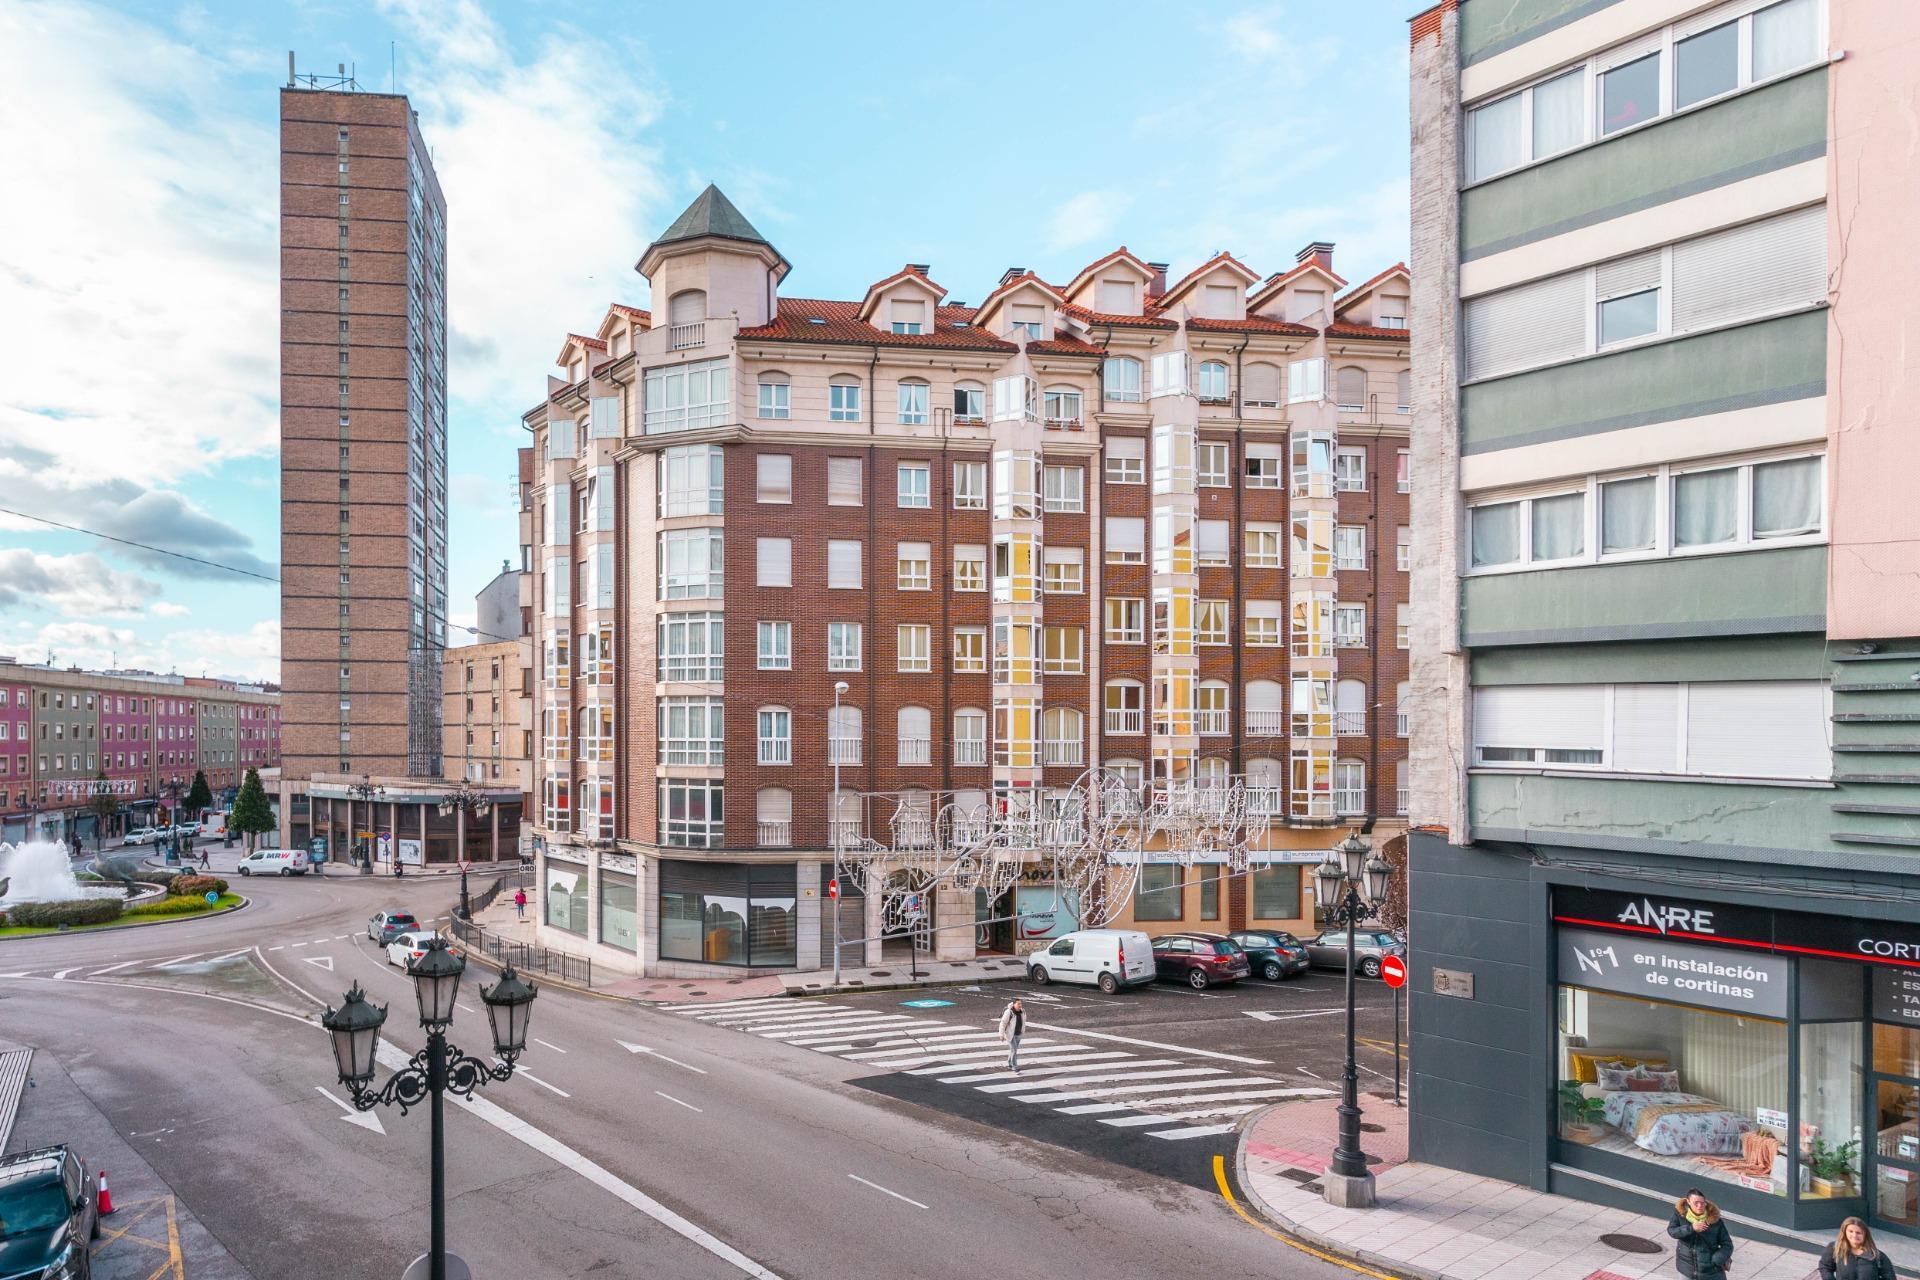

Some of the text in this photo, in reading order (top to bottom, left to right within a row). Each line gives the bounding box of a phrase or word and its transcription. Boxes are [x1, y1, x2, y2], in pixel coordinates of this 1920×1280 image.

[1617, 898, 1716, 935] ANRE
[1858, 939, 1920, 960] CORT
[1633, 953, 1769, 983] en instalación
[1645, 971, 1755, 999] de cortinas
